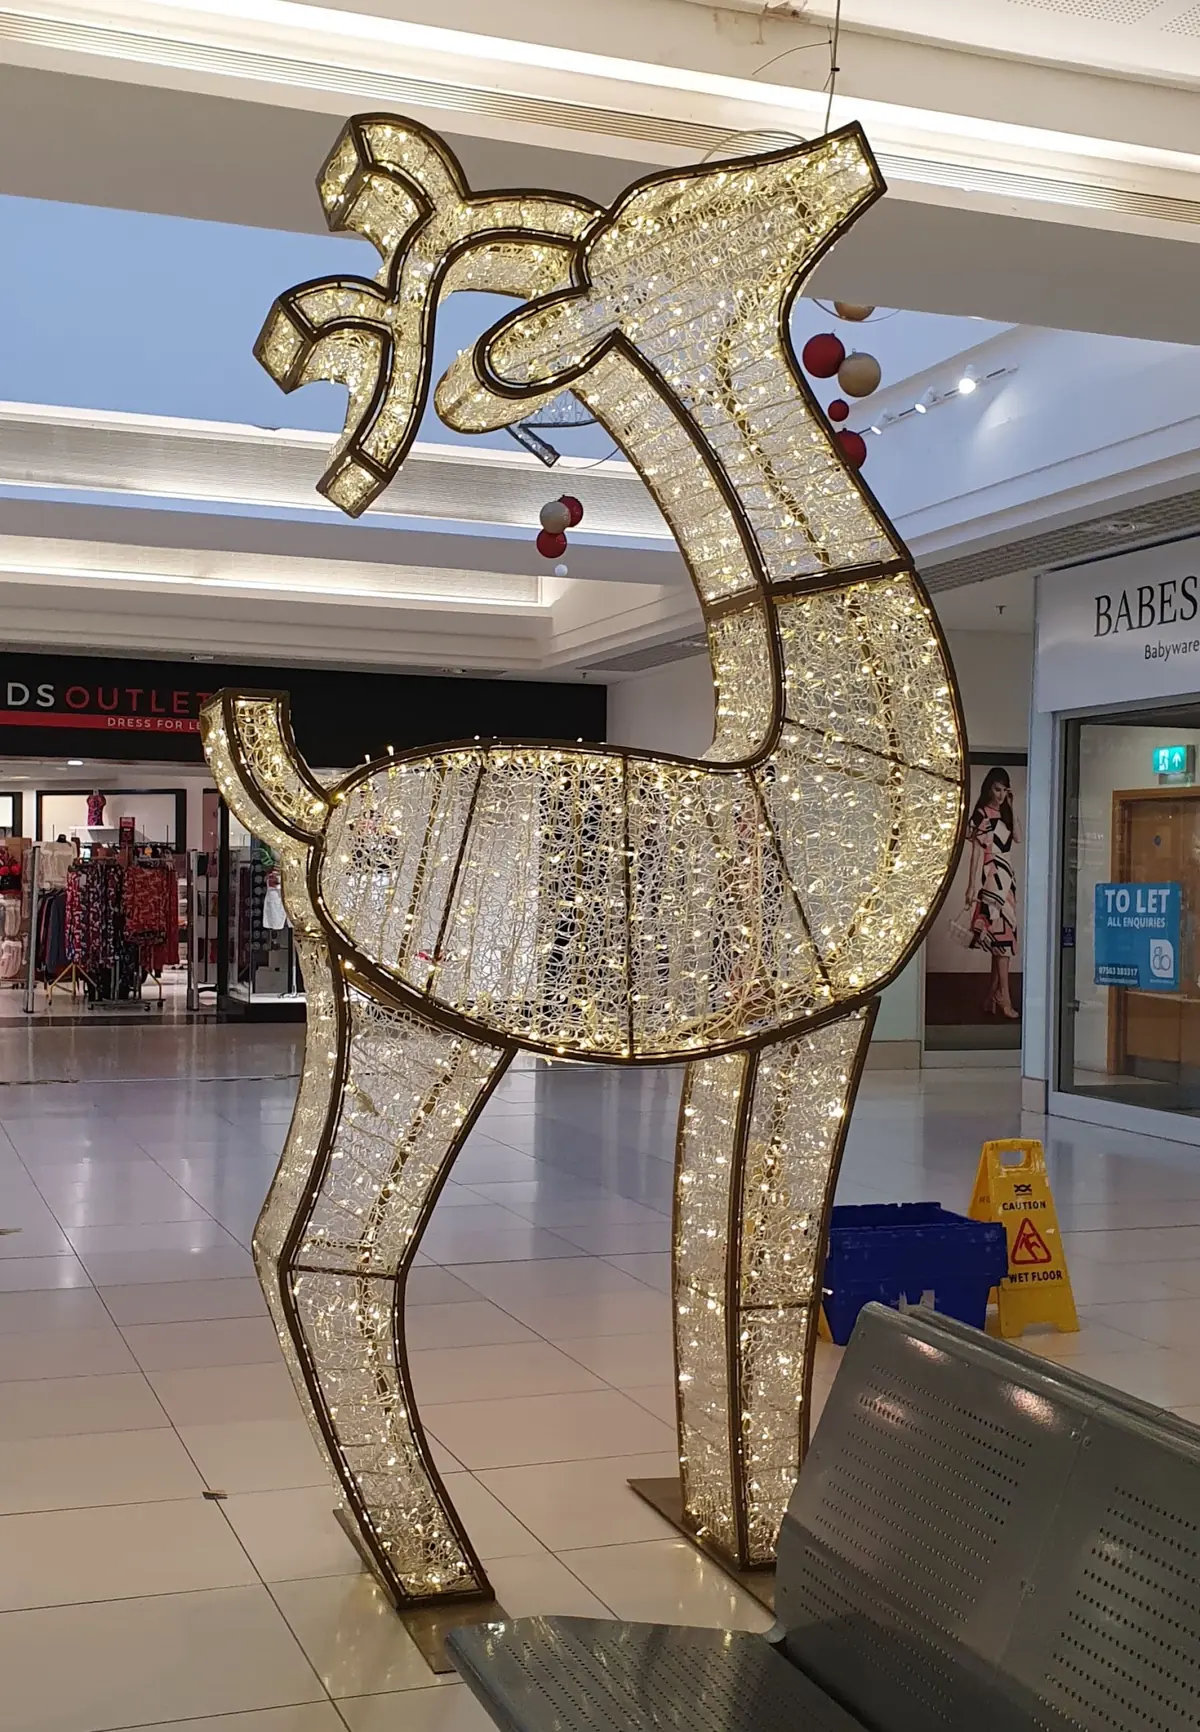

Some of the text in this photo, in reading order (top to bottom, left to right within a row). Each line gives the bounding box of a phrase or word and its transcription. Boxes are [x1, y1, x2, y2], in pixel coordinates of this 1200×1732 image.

[1094, 575, 1199, 638] BABES
[1144, 639, 1200, 662] Babyware
[107, 717, 151, 728] DRESS
[157, 719, 183, 730] FOR
[1104, 888, 1170, 914] TO LET
[1107, 916, 1166, 929] ALL ENQUIRIES
[1002, 1200, 1046, 1211] CAUTION
[1008, 1270, 1063, 1284] WET FLOOR
